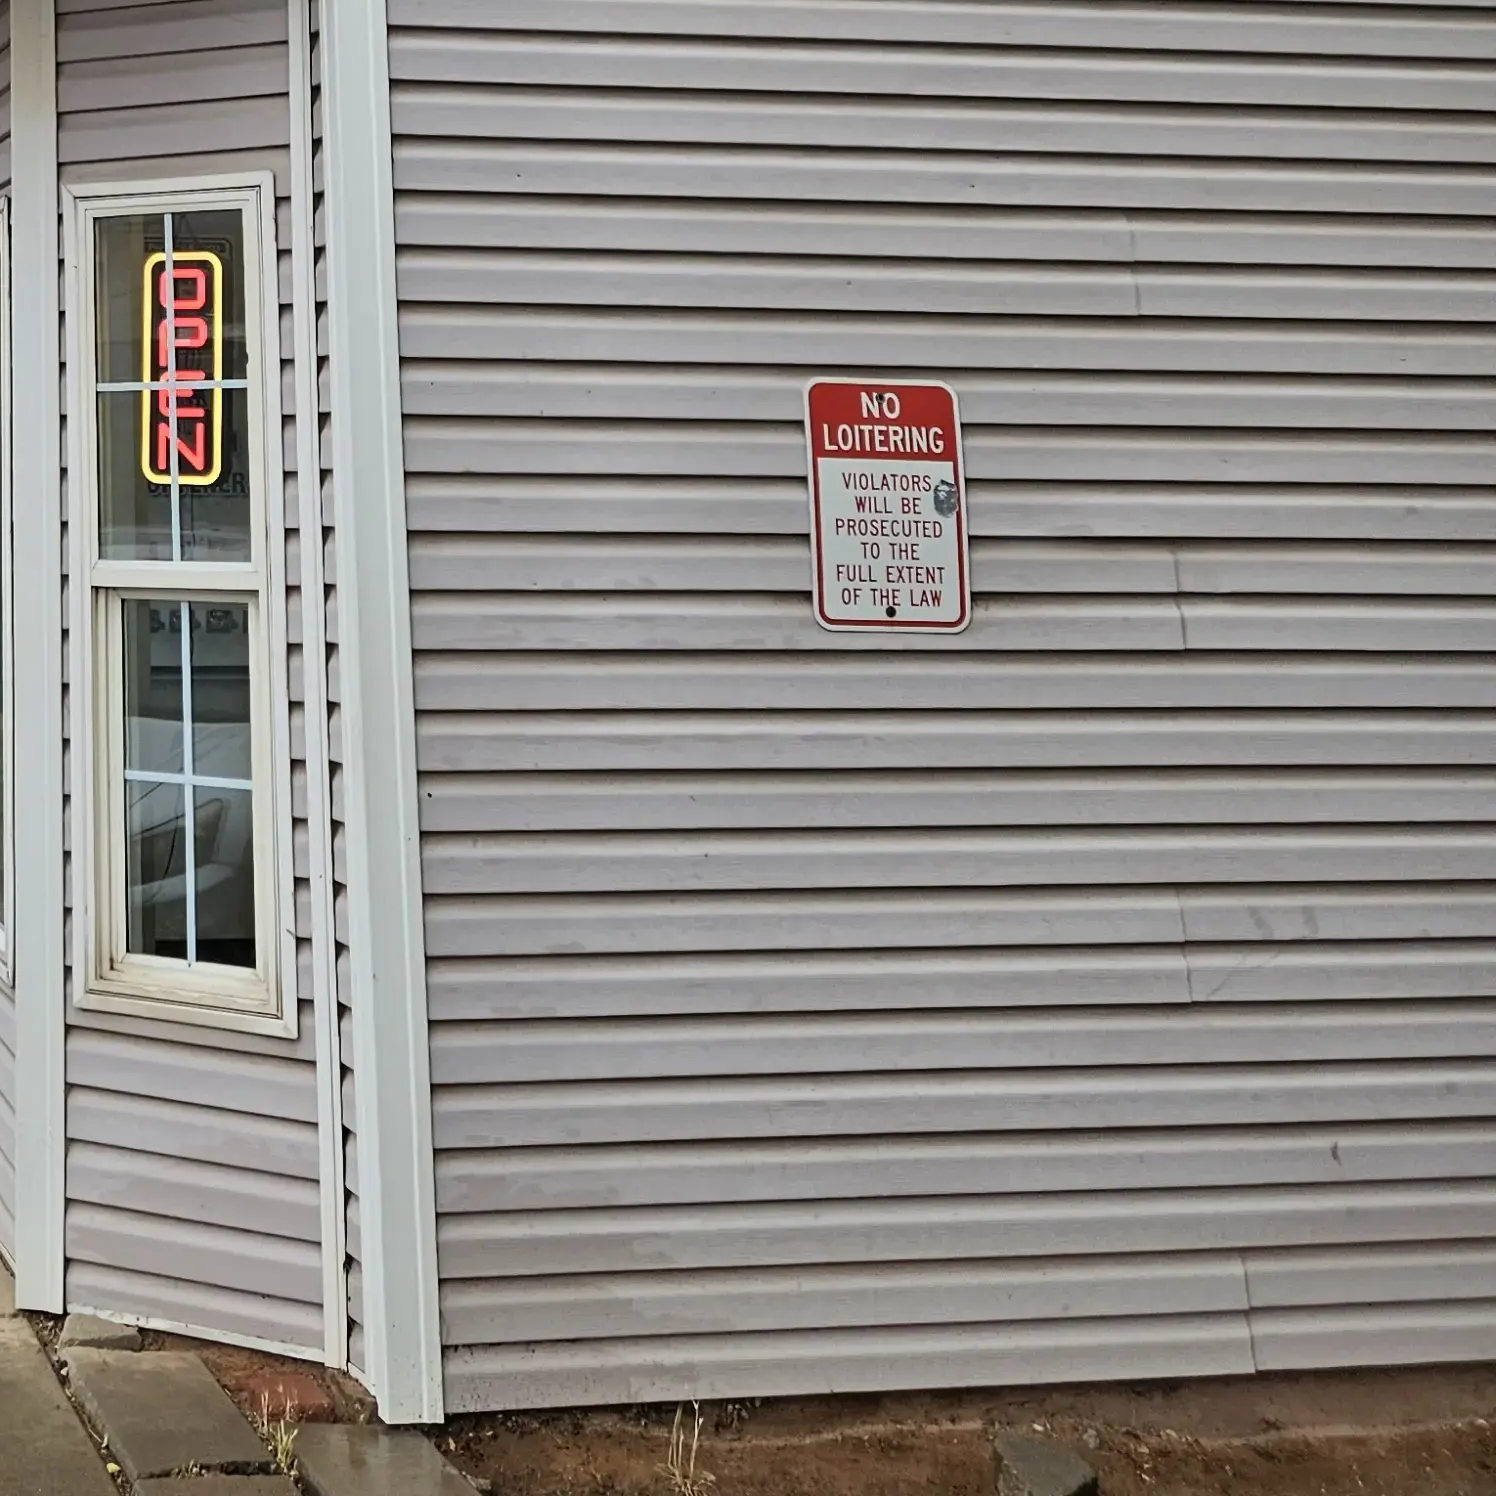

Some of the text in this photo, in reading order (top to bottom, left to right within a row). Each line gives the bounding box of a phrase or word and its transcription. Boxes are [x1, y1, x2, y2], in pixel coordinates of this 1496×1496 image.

[157, 267, 208, 471] OPEN
[859, 391, 901, 419] NO
[822, 423, 945, 454] LOITERING
[841, 472, 933, 492] VIOLATORS
[854, 495, 922, 515] WILL BE
[835, 518, 943, 538] PROSECUTED
[859, 542, 920, 561] TO THE
[836, 564, 946, 584] FULL EXTENT
[841, 588, 942, 608] OF THE LAW
